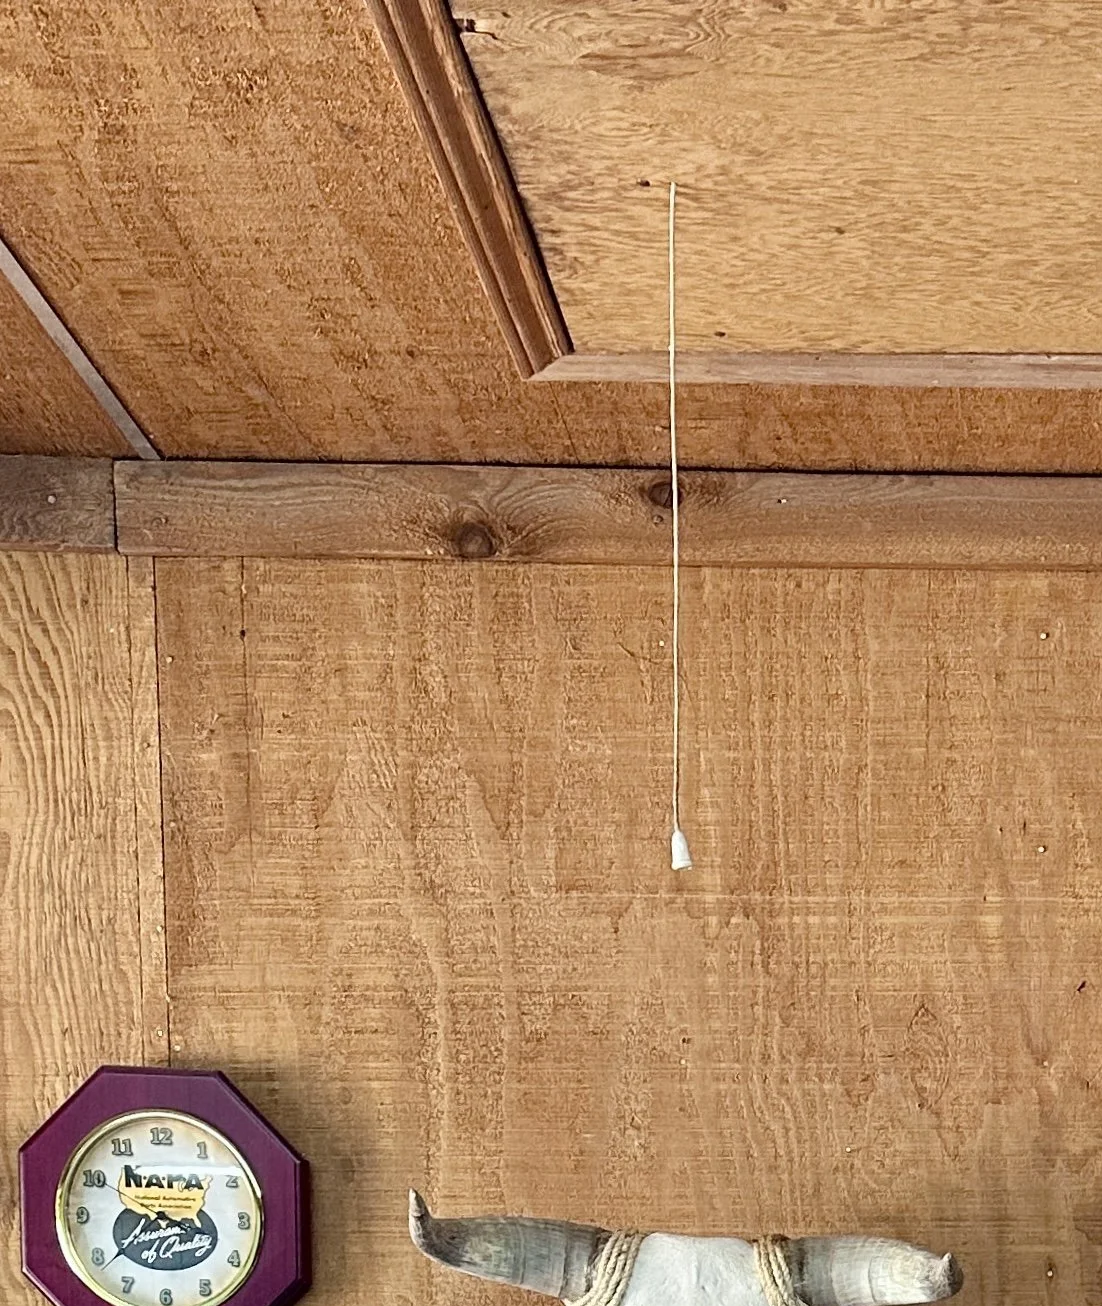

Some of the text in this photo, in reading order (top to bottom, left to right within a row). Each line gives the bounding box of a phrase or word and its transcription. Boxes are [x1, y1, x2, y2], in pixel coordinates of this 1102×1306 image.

[150, 1127, 173, 1145] 12
[111, 1138, 133, 1156] 11
[197, 1141, 208, 1159] 1
[83, 1169, 106, 1187] 10
[225, 1174, 239, 1188] 2
[76, 1206, 90, 1224] 9
[237, 1212, 251, 1230] 3
[91, 1247, 104, 1266] 8
[141, 1234, 212, 1264] of Quality
[227, 1250, 241, 1267] 4
[121, 1276, 135, 1294] 7
[199, 1279, 212, 1297] 5
[159, 1288, 173, 1306] 6
